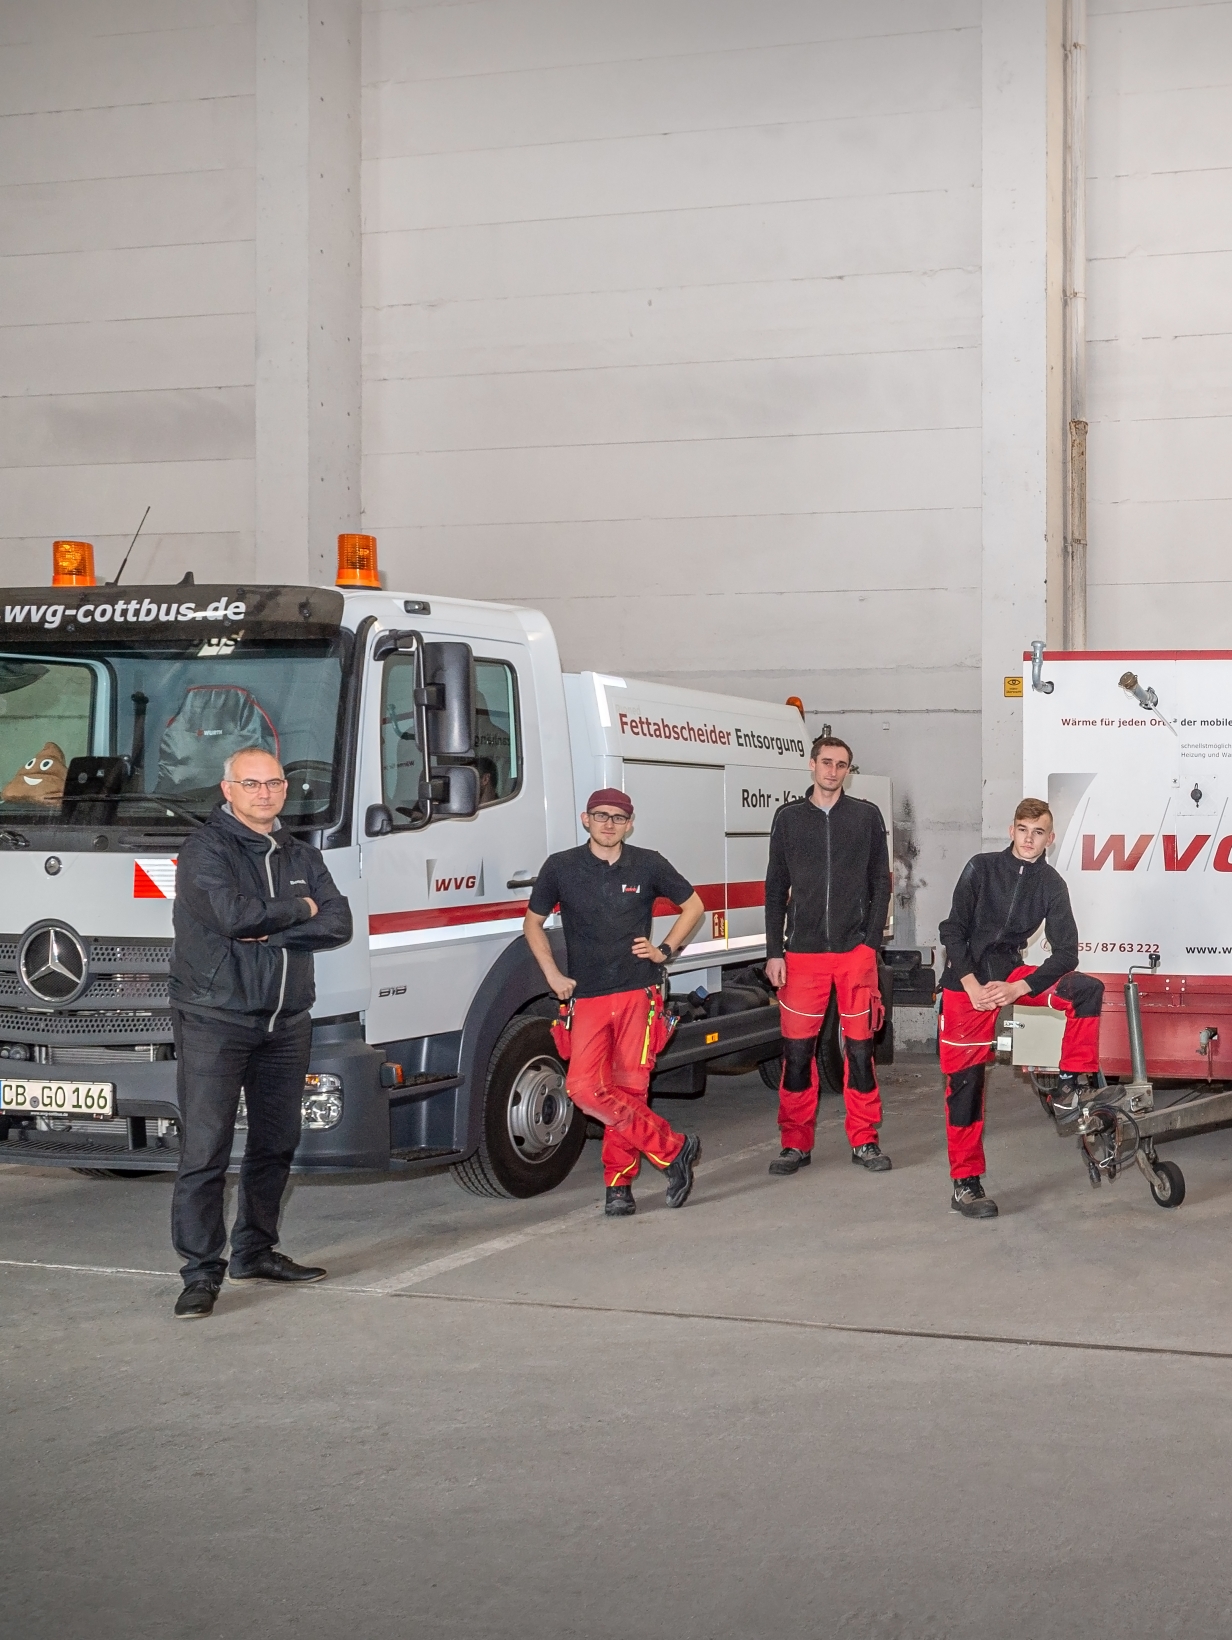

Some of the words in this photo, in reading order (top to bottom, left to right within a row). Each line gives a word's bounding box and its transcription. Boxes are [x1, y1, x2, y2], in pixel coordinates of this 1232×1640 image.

[4, 597, 246, 628] wvg-cottbus.de
[1061, 717, 1097, 727] Wärme
[1100, 717, 1115, 727] für
[1118, 717, 1147, 728] jeden
[1180, 718, 1197, 727] der
[618, 712, 731, 746] Fettabscheider
[734, 728, 805, 757] Entsorgung
[1180, 752, 1206, 760] Heizung
[741, 788, 772, 808] Rohr
[435, 875, 477, 893] WVG
[2, 1084, 27, 1107] CB
[41, 1086, 67, 1109] GO
[72, 1087, 108, 1110] 166
